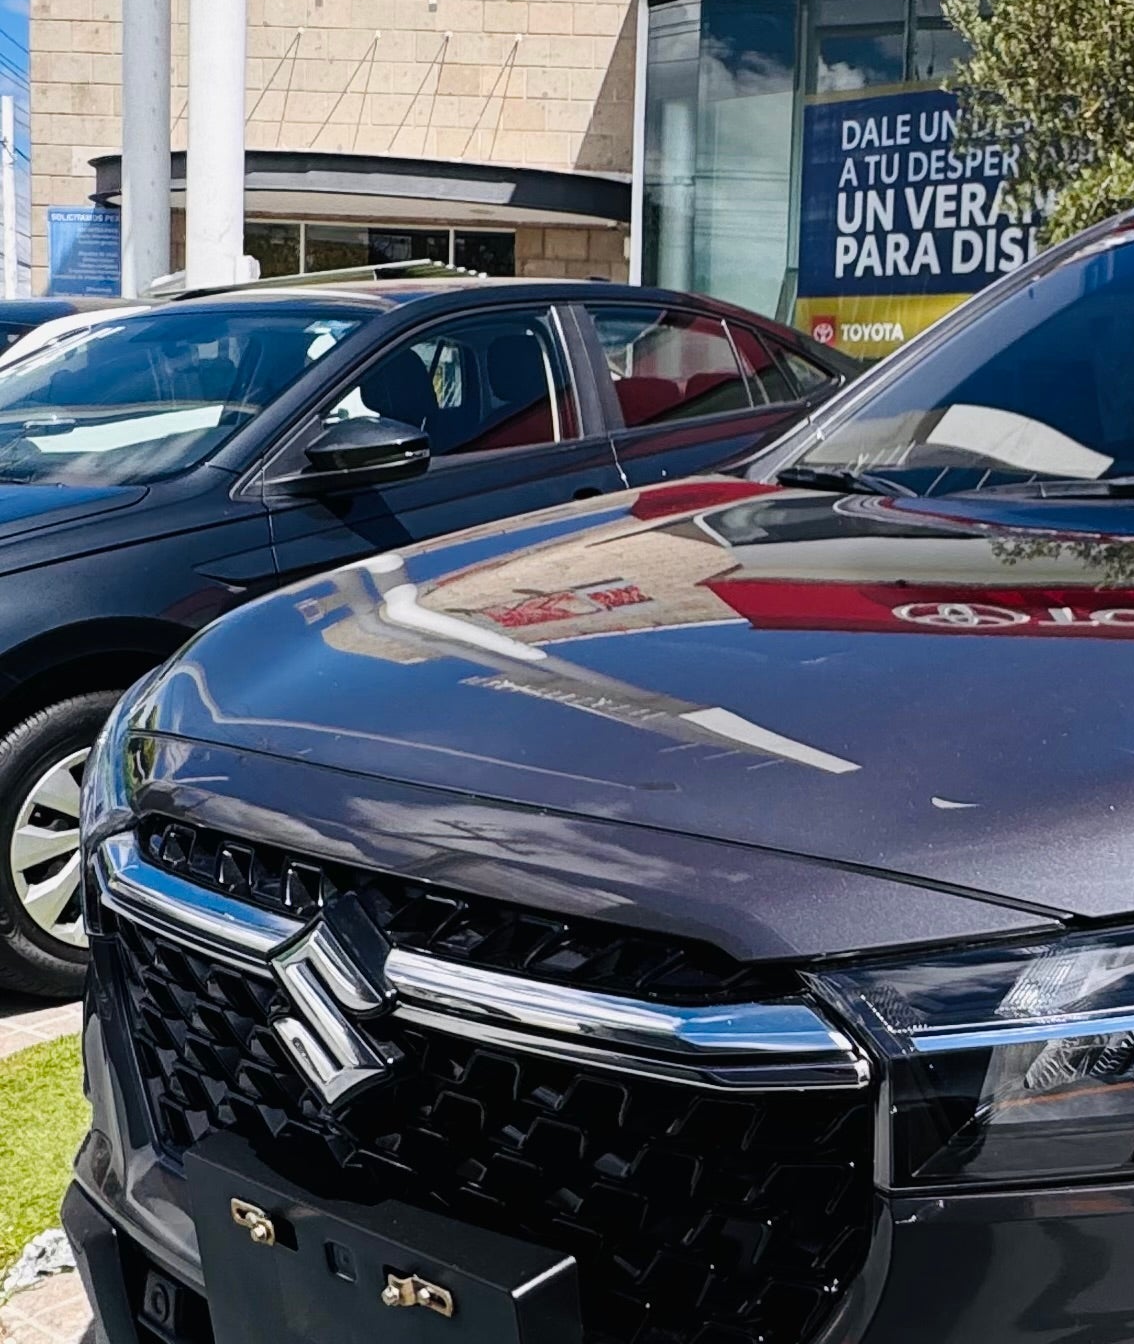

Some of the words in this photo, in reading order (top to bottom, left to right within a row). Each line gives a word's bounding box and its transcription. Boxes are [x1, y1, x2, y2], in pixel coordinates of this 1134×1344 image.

[841, 113, 912, 151] DALE
[837, 157, 859, 188] A
[863, 152, 900, 185] TU
[836, 188, 895, 234] UN
[834, 231, 942, 279] PARA
[841, 321, 905, 342] TOYOTA
